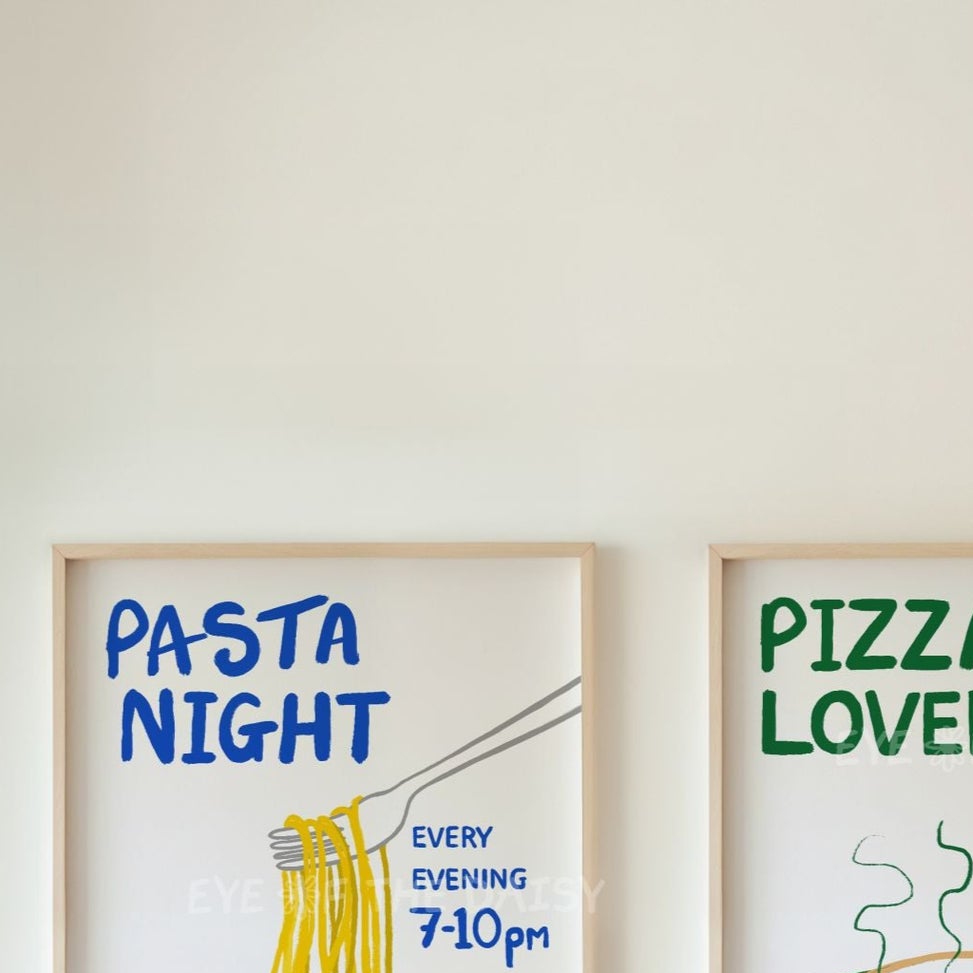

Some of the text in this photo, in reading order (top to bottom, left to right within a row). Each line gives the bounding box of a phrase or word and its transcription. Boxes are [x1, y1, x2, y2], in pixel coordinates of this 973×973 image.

[106, 595, 360, 678] PASTA
[121, 688, 390, 765] NIGHT
[412, 826, 494, 849] EVERY
[412, 867, 528, 891] EVENING
[410, 907, 550, 968] 7-10pm
